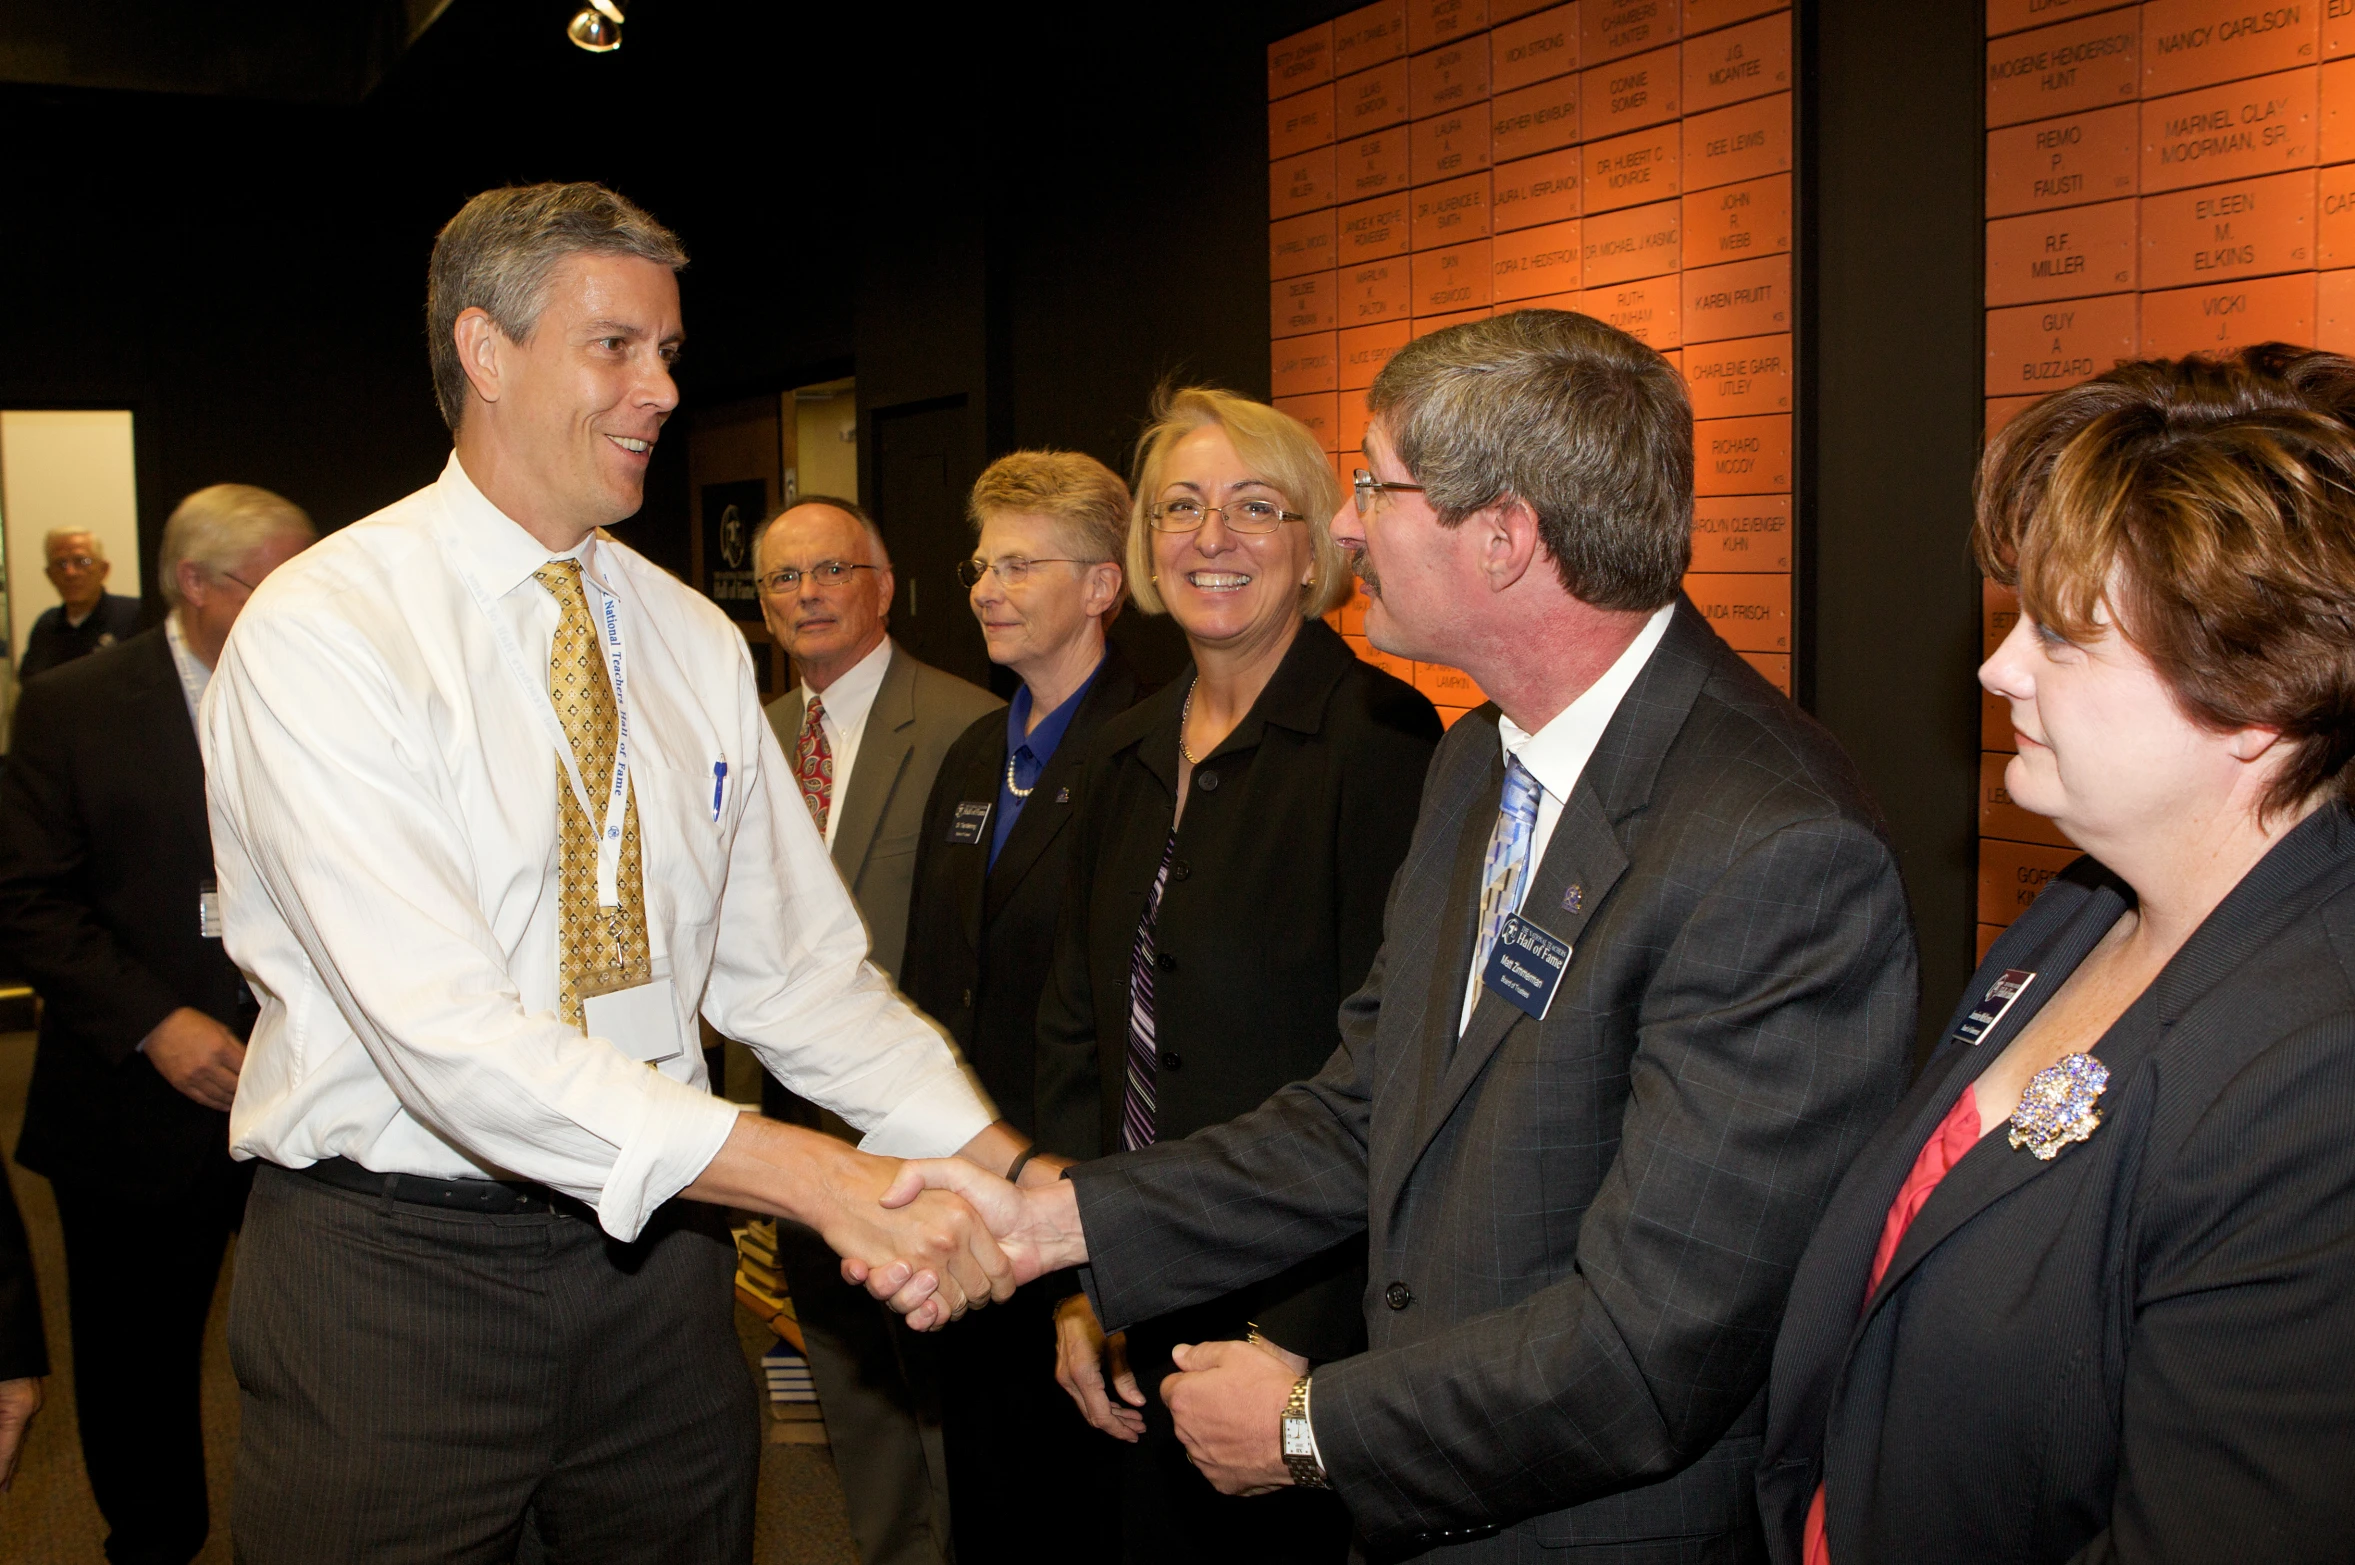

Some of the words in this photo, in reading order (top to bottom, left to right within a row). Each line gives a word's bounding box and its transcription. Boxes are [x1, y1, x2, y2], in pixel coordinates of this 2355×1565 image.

[1609, 24, 1650, 48] HUNTER
[2158, 25, 2214, 56] NANCY
[2219, 6, 2301, 42] CARLSON
[1528, 33, 1565, 57] STRONG
[1989, 52, 2048, 82] IMOGENE
[2050, 33, 2135, 67] HENDERSON
[1609, 70, 1650, 95] CONNIE
[1708, 58, 1761, 87] MCANTEE
[2040, 68, 2078, 92] HUNT
[1493, 112, 1531, 136] HEATHER
[1533, 102, 1577, 125] NEWBURY
[2240, 97, 2289, 125] CLAY
[1705, 140, 1728, 158] DEE
[1730, 130, 1766, 151] LEWIS
[2036, 126, 2082, 149] REMO
[1614, 148, 1652, 171] HUBERT
[1608, 167, 1651, 190] MONROE
[2033, 174, 2083, 198] FAUSTI
[1720, 191, 1751, 211] JOHN
[2195, 193, 2256, 220] EILEEN
[1437, 213, 1462, 230] SMITH
[1599, 237, 1636, 258] MICHAEL
[1719, 231, 1751, 252] WEBB
[1530, 247, 1579, 268] HEDSTROM
[2031, 255, 2085, 279] MILLER
[2193, 244, 2256, 271] ELKINS
[1616, 289, 1645, 308] RUTH
[1694, 292, 1732, 311] KAREN
[1733, 284, 1773, 306] PRUITT
[2202, 293, 2247, 317] VICKI
[2041, 311, 2076, 333] GUY
[1692, 358, 1748, 381] CHARLENE
[2022, 357, 2095, 381] BUZZARD
[1717, 379, 1752, 397] UTLEY
[1711, 437, 1760, 455] RICHARD
[1715, 458, 1756, 475] MCCOY
[1730, 516, 1787, 534] CLEVENGER
[1722, 537, 1750, 552] KUHN
[604, 600, 621, 647] National
[1731, 604, 1771, 621] FRISCH
[612, 652, 625, 705] Teachers
[620, 711, 629, 738] Hall
[620, 742, 628, 759] of
[614, 764, 626, 797] Fame
[1500, 953, 1514, 969] Matt
[1516, 932, 1534, 952] Hall
[1532, 943, 1544, 957] of
[1540, 947, 1563, 970] Fame
